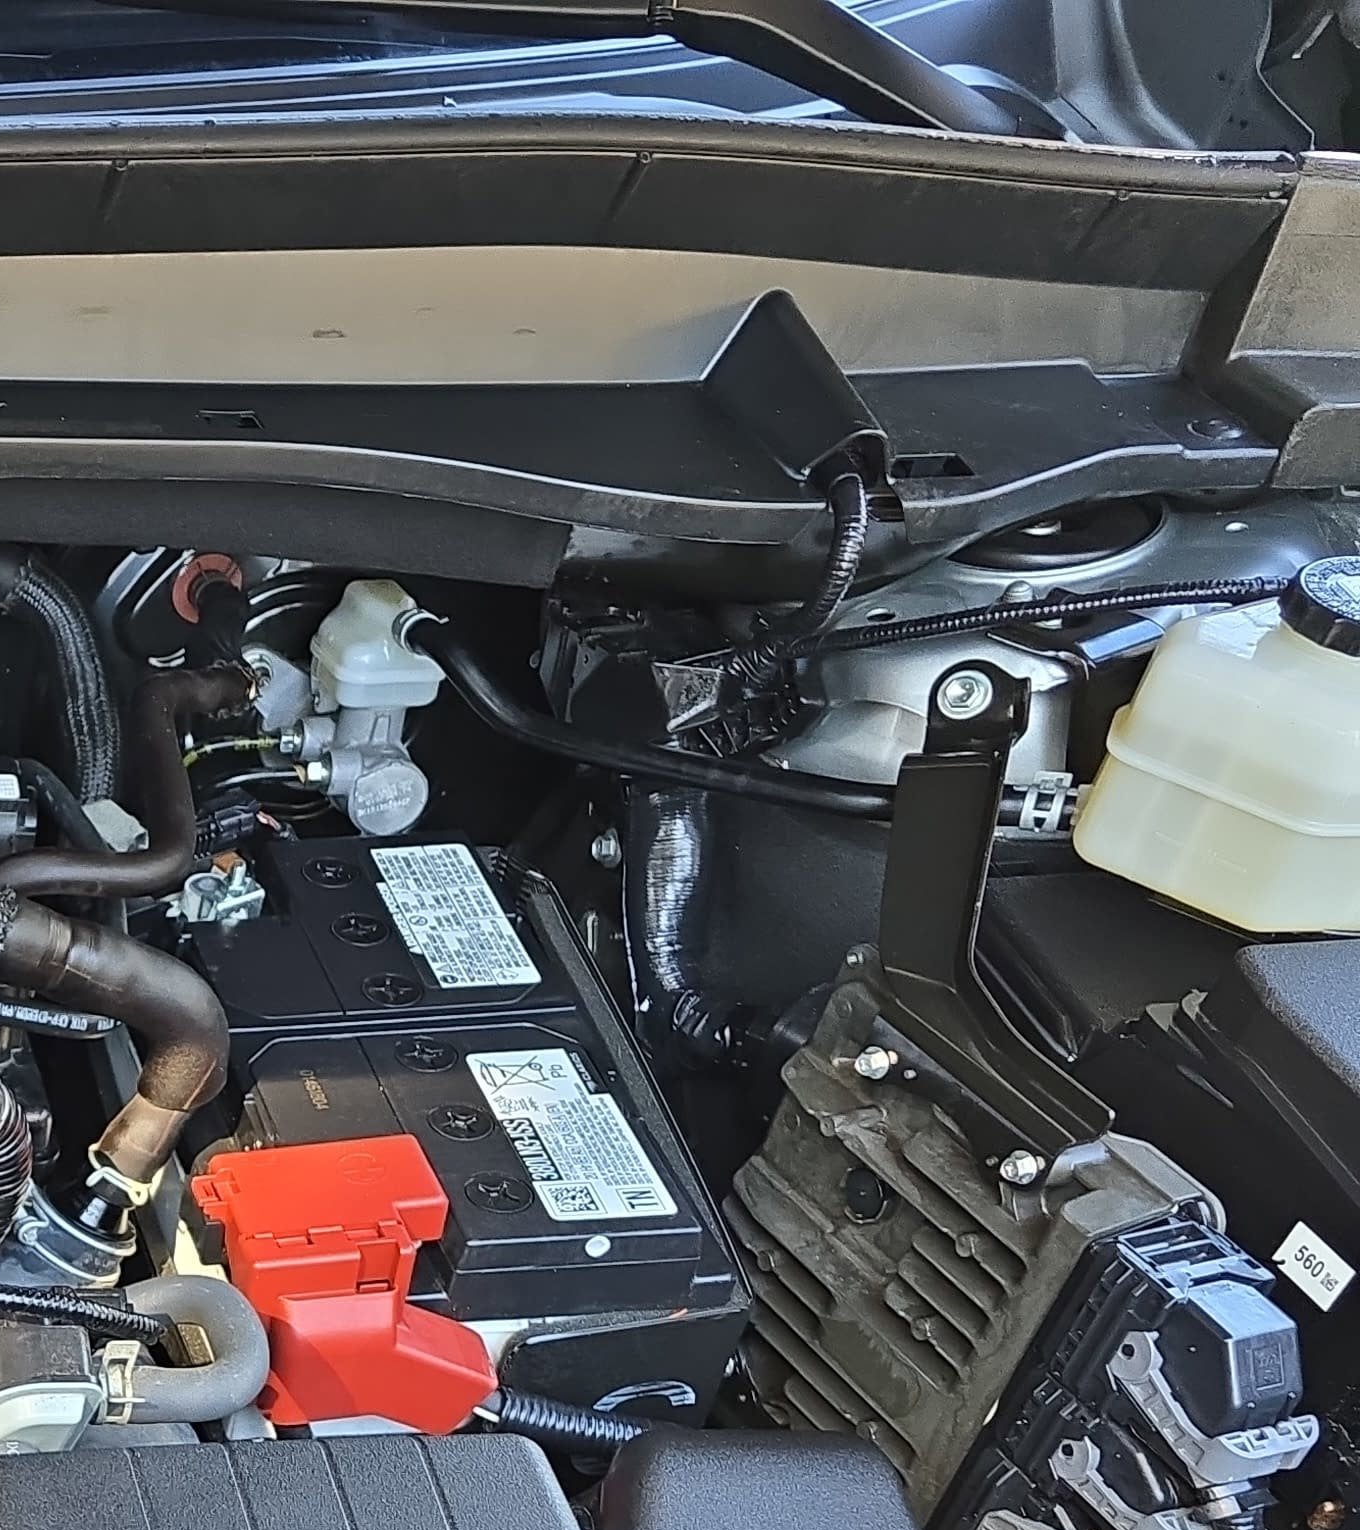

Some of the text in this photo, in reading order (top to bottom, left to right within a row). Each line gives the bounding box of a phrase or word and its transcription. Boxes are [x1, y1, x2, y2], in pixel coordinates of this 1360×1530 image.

[552, 1064, 568, 1079] Pb
[622, 1190, 659, 1210] TN
[1293, 1245, 1323, 1283] 560
